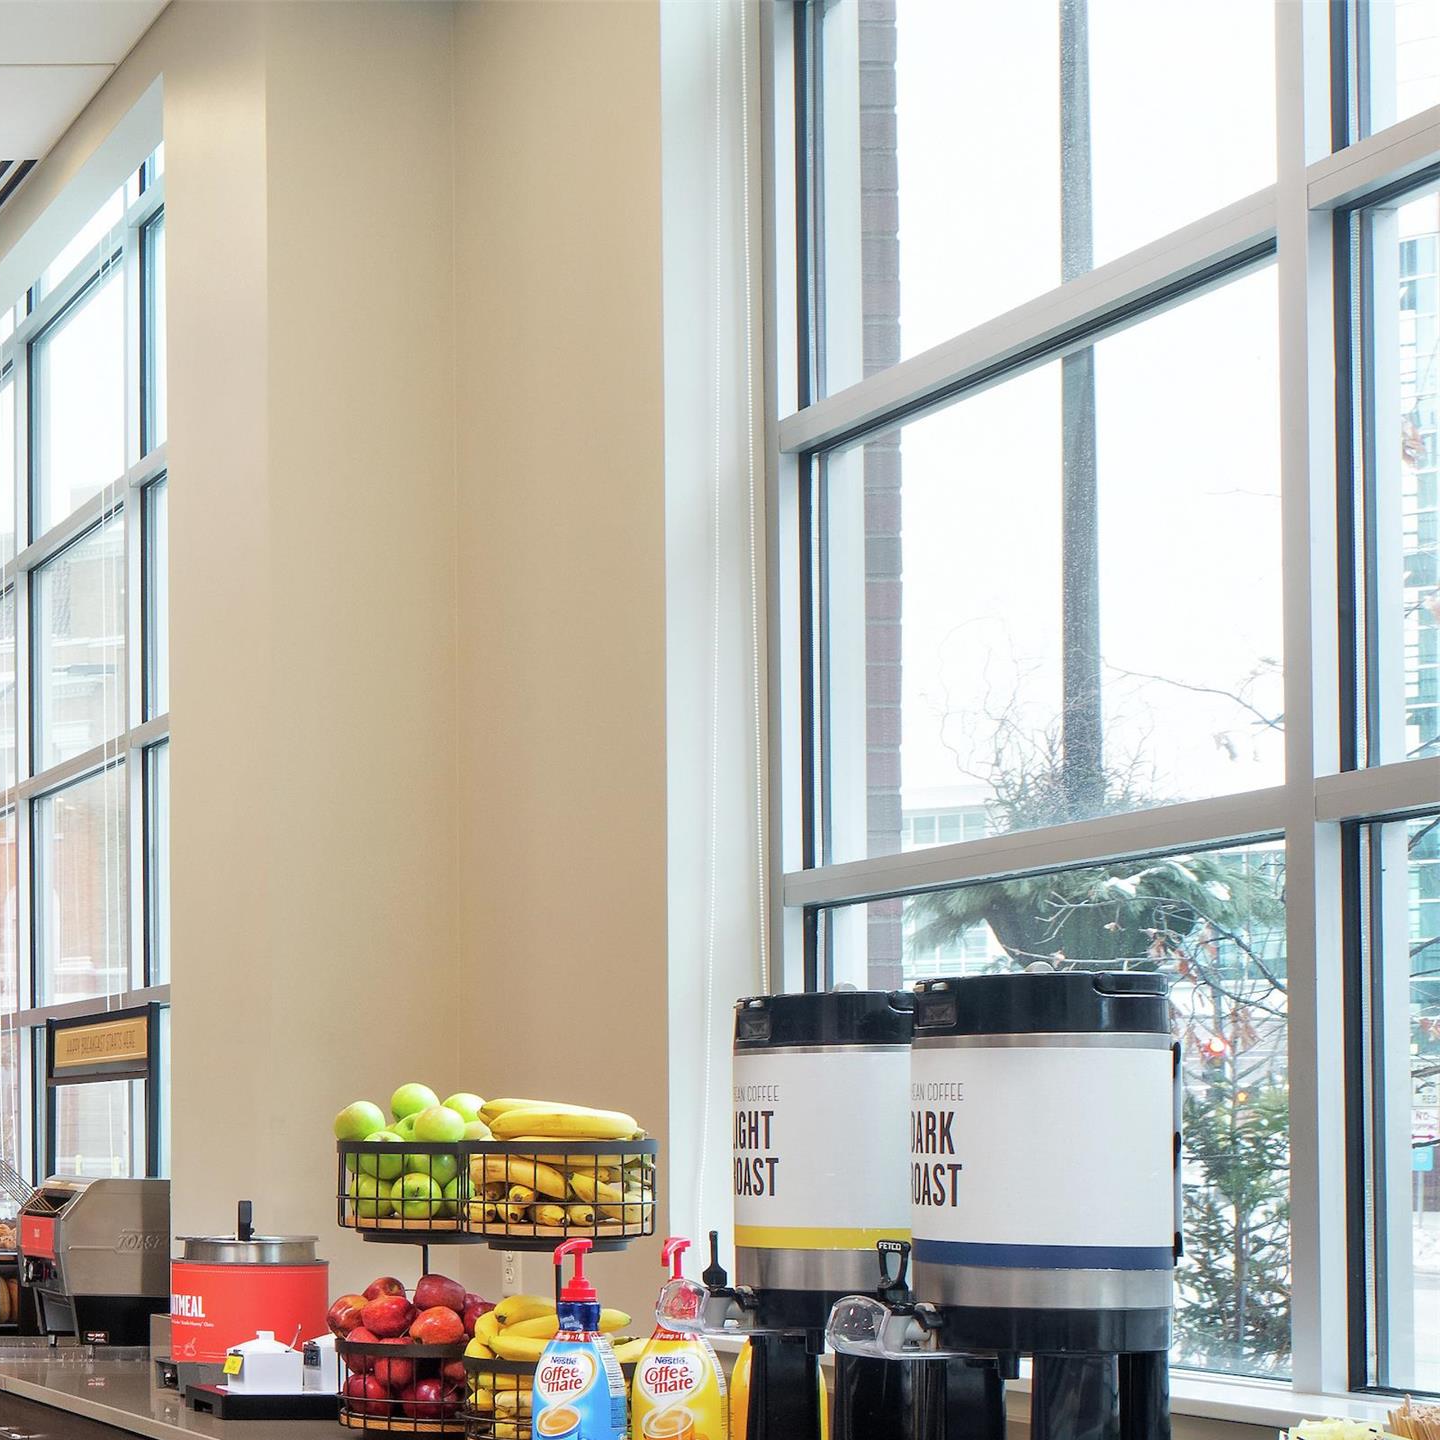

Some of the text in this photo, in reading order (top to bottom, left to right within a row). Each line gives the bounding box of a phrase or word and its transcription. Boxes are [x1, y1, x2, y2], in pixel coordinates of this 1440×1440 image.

[733, 1085, 780, 1102] EAN COFFEE
[911, 1082, 964, 1101] EAN COFFEE
[733, 1110, 774, 1149] IGHT
[877, 1241, 902, 1251] FETCO
[547, 1378, 582, 1392] mate
[654, 1378, 693, 1393] mate
